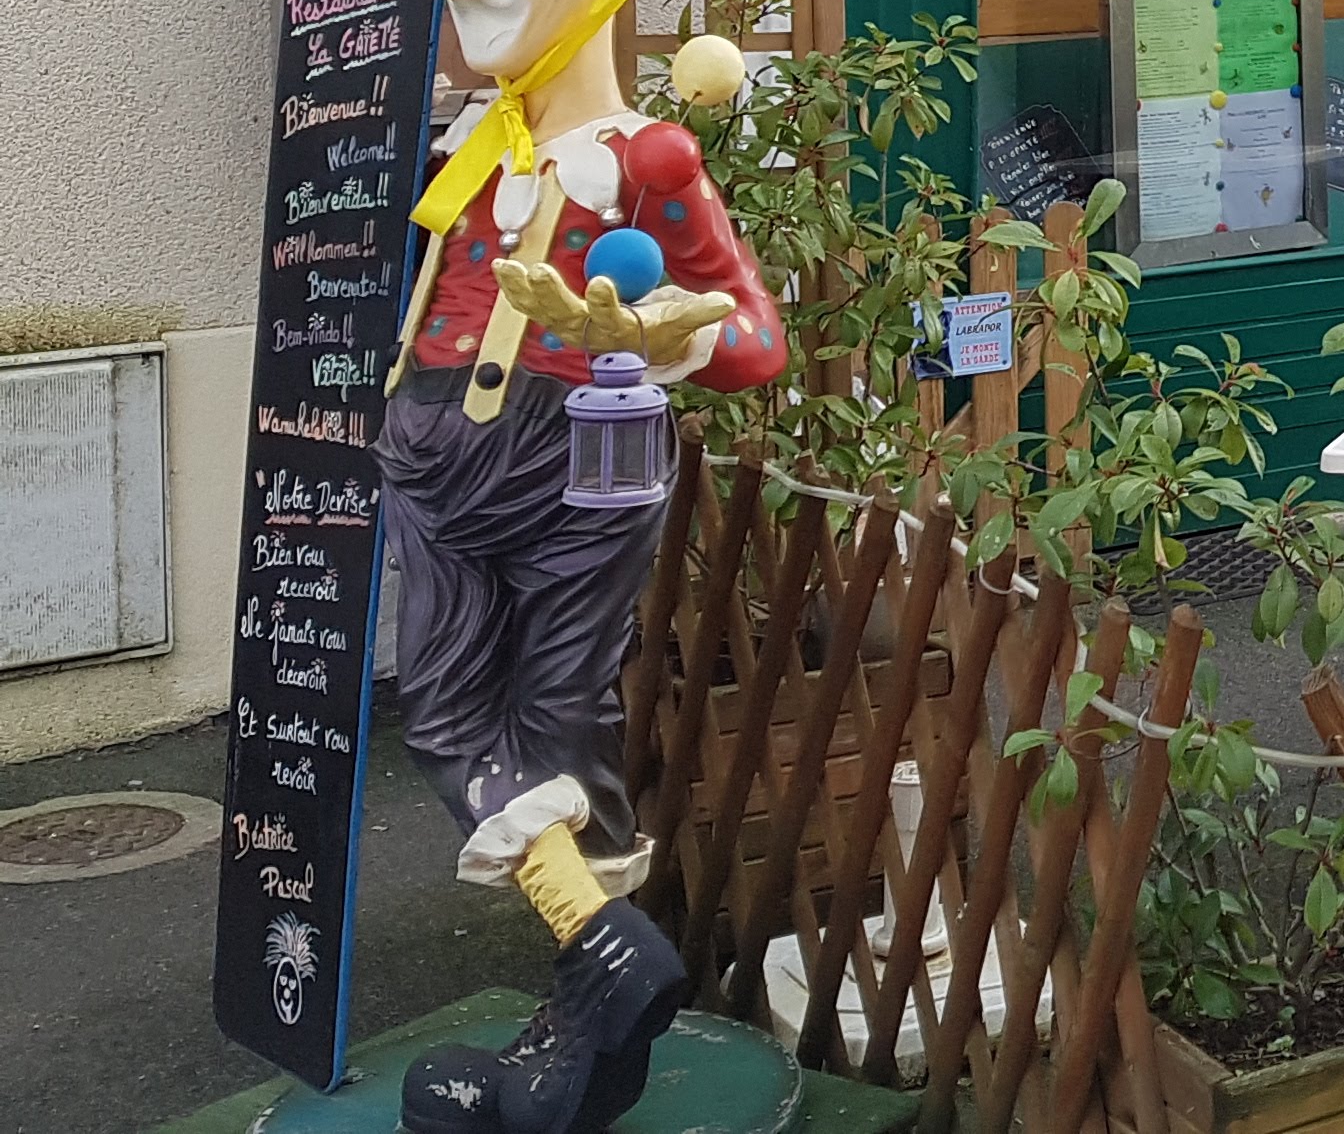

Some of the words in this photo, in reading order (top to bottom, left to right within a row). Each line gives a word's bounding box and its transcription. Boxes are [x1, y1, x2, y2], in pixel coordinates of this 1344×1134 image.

[306, 32, 333, 66] La
[955, 302, 1003, 315] ATTENTION
[955, 322, 1002, 336] LABRADOR
[960, 345, 970, 355] JE
[972, 342, 999, 353] MONTE
[973, 354, 999, 365] GARDE
[251, 530, 295, 572] Bien
[268, 602, 316, 666] jamais
[237, 696, 258, 739] Et
[233, 813, 298, 860] Béatrice
[259, 862, 314, 904] Pascal
